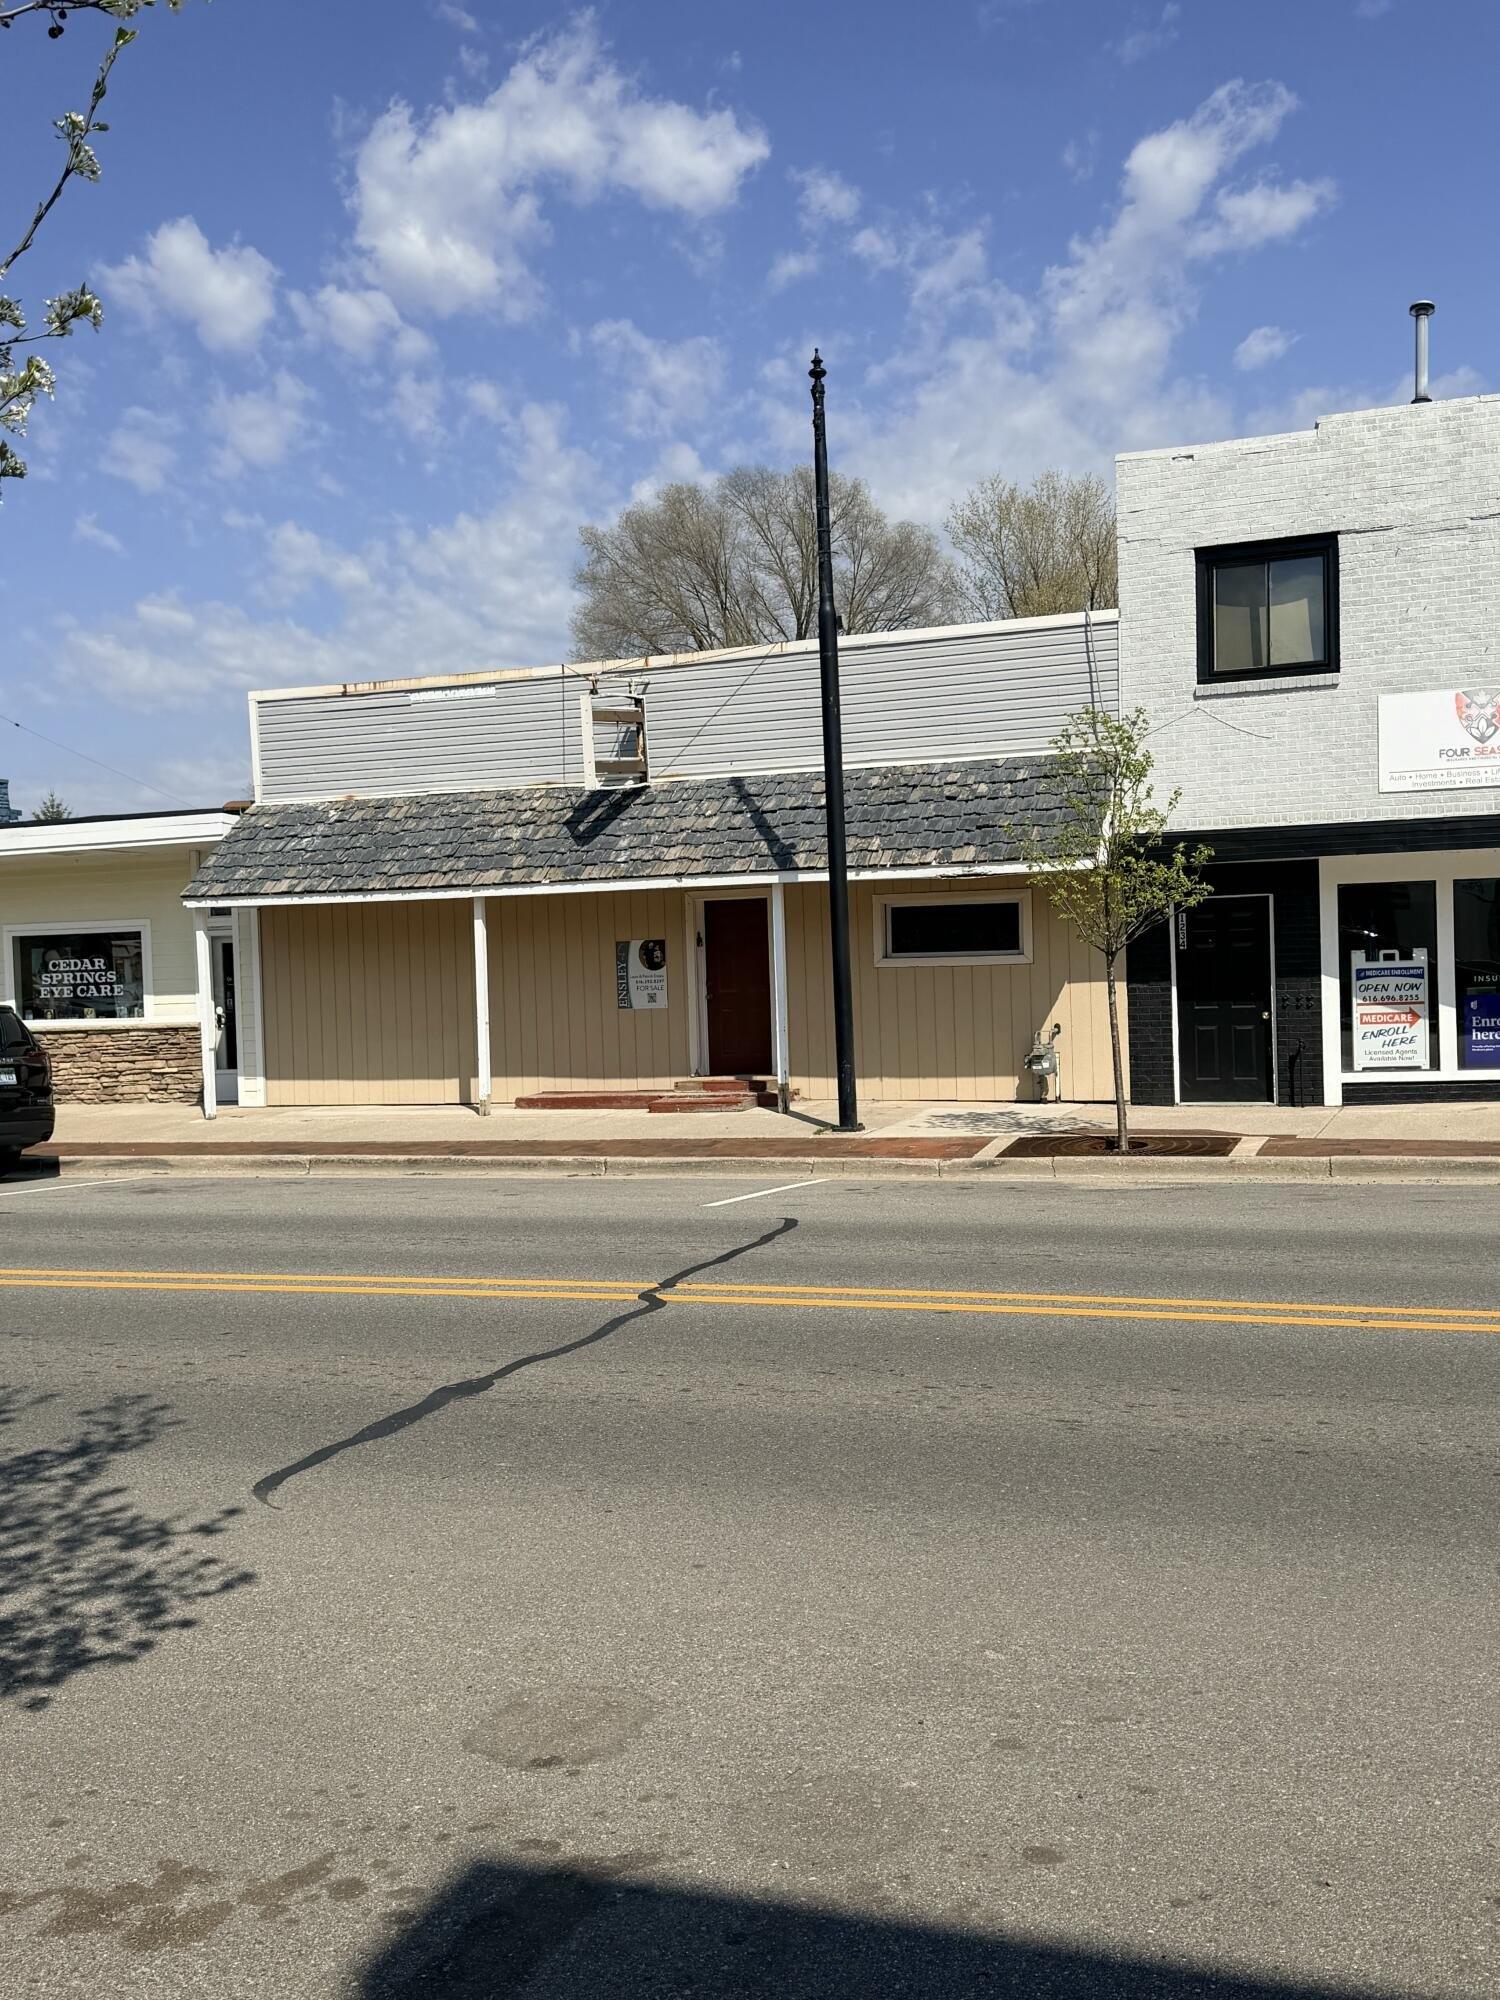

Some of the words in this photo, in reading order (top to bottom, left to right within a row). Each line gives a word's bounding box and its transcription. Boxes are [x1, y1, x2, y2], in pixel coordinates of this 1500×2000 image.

[1439, 747, 1470, 758] FOUR
[1389, 774, 1407, 782] Auto
[1415, 772, 1438, 780] Home
[1446, 770, 1481, 778] Business
[1412, 779, 1457, 788] Investments
[1465, 777, 1483, 785] Real
[48, 957, 106, 972] CEDAR
[41, 970, 117, 985] SPRINGS
[617, 960, 628, 1007] ENSLEY
[39, 985, 74, 999] EYE
[76, 984, 124, 998] CARE
[1358, 983, 1390, 993] OPEN
[1394, 982, 1423, 992] NOW
[1362, 994, 1420, 1002] 616.696.8255
[1362, 1013, 1413, 1023] MEDICARE
[1361, 1025, 1409, 1041] ENROLL
[1471, 1028, 1500, 1041] here
[1381, 1035, 1418, 1048] HERE
